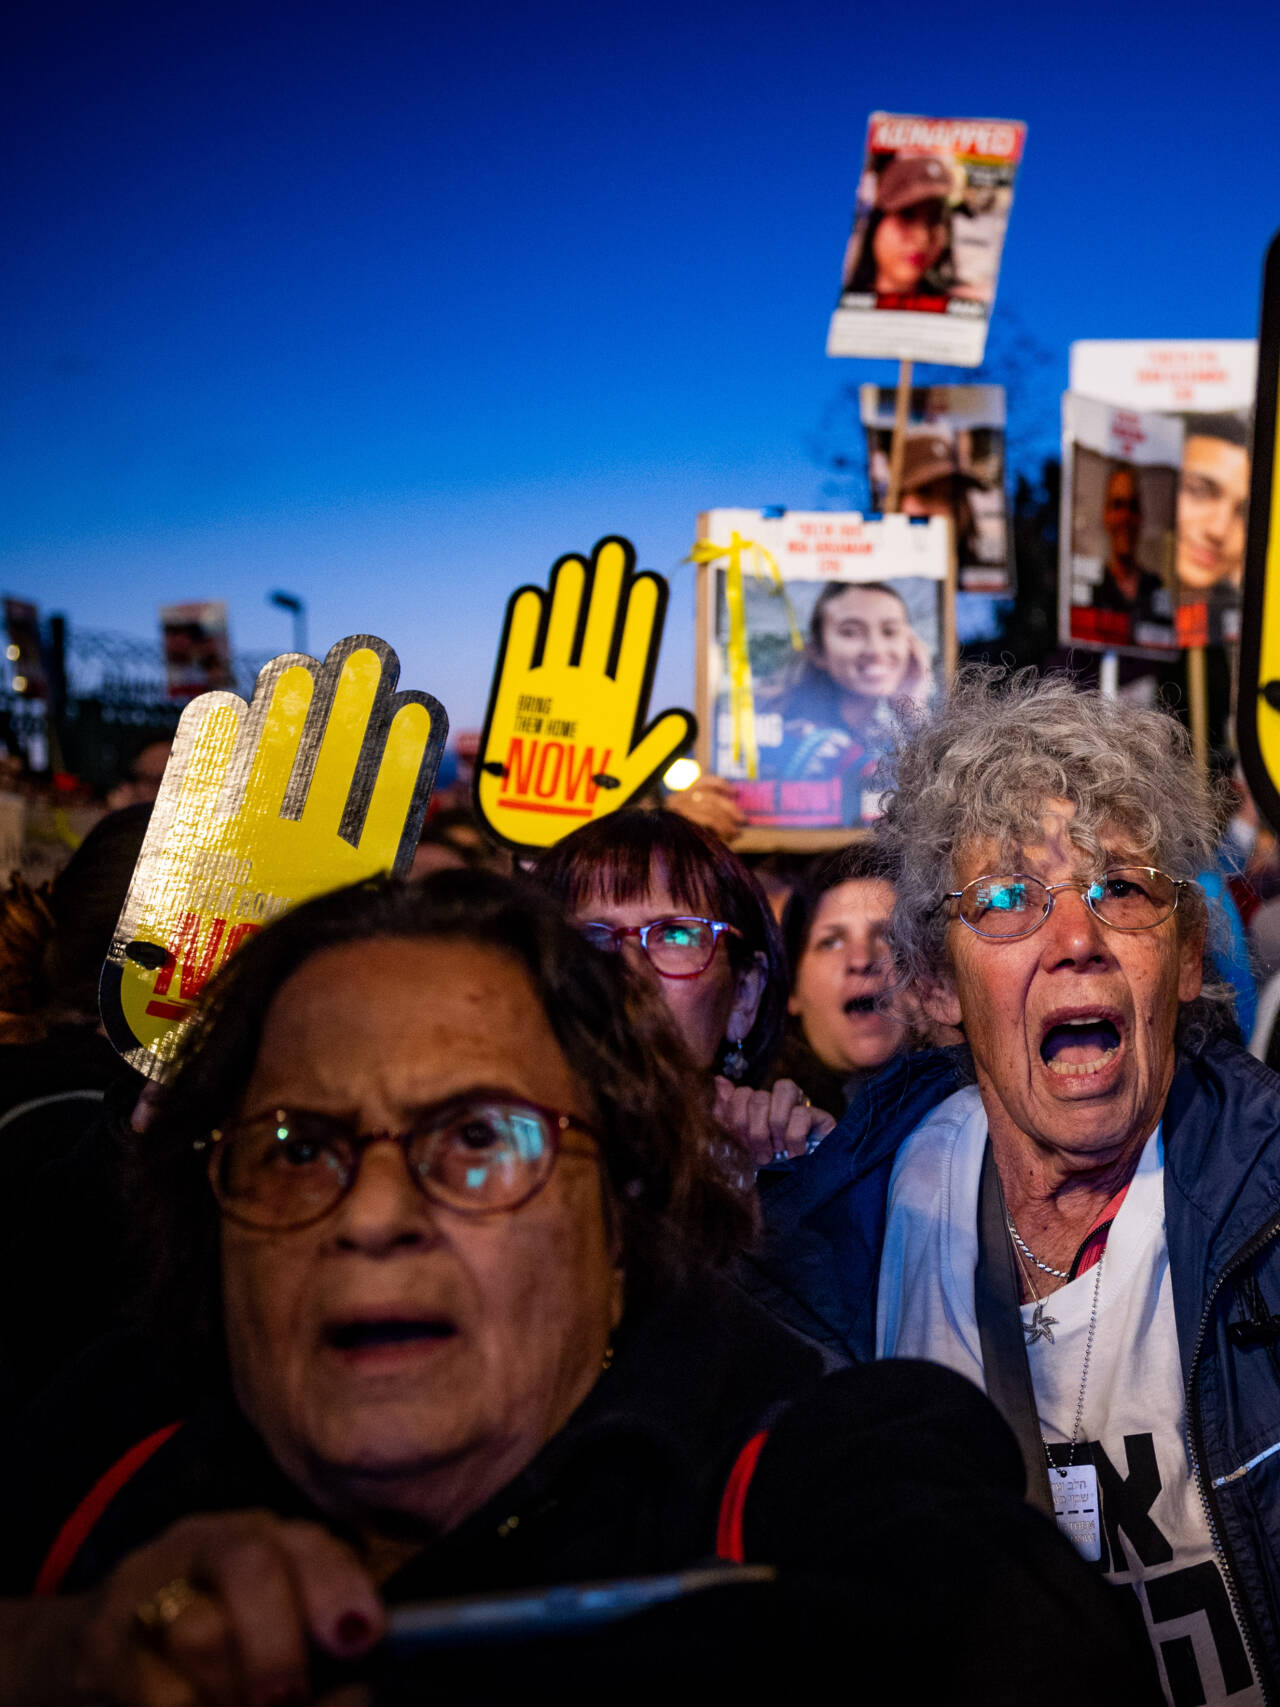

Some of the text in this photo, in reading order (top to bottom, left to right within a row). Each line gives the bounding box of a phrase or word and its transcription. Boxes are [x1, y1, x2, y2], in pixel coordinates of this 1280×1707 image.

[517, 694, 552, 715] BRING
[514, 715, 577, 738] THEM HOME
[501, 737, 613, 804] NOW
